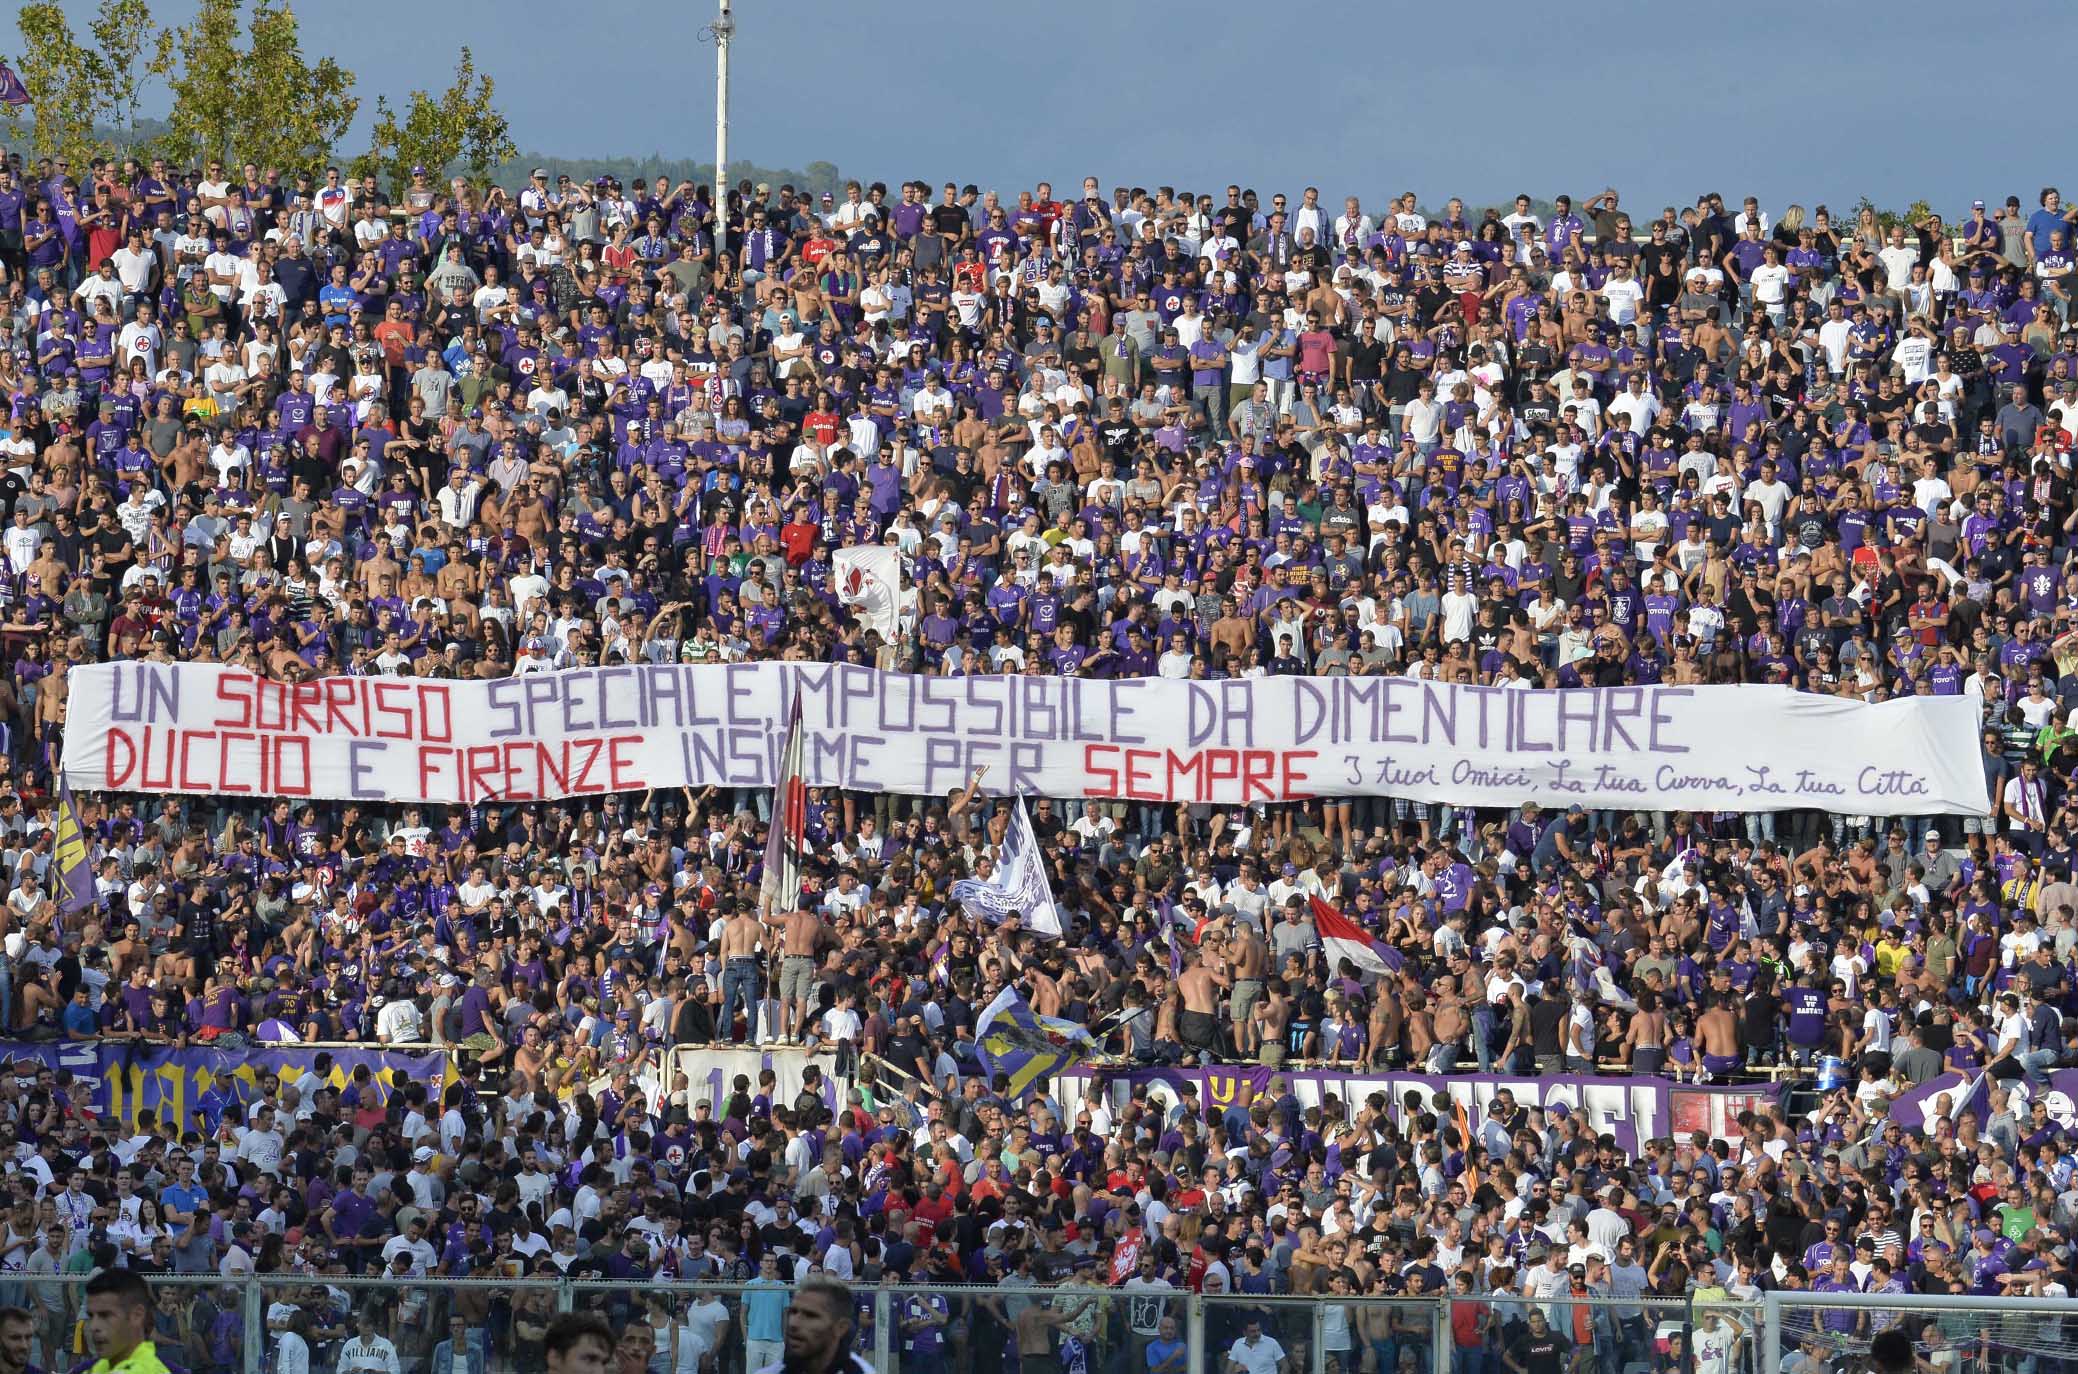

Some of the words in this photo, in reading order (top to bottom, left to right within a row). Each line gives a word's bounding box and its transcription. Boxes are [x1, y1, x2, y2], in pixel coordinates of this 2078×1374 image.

[1105, 438, 1124, 446] BOY
[111, 665, 179, 723] UN
[214, 673, 452, 743] SORRISO
[488, 664, 773, 738] SPECIALE,
[779, 664, 1146, 744] IMPOSSIBILE
[1188, 680, 1253, 748] DA
[1294, 678, 1694, 753] DIMENTICARE
[105, 725, 311, 796] DUCCIO
[351, 741, 387, 798] E
[419, 735, 646, 803] FIRENZE
[925, 738, 1042, 796] PER
[1084, 744, 1319, 803] SEMPRE
[1376, 756, 1440, 785] tuoi
[1547, 759, 1585, 792] La
[1593, 763, 1647, 792] tua
[1746, 765, 1786, 793] La
[1795, 769, 1846, 795] tua
